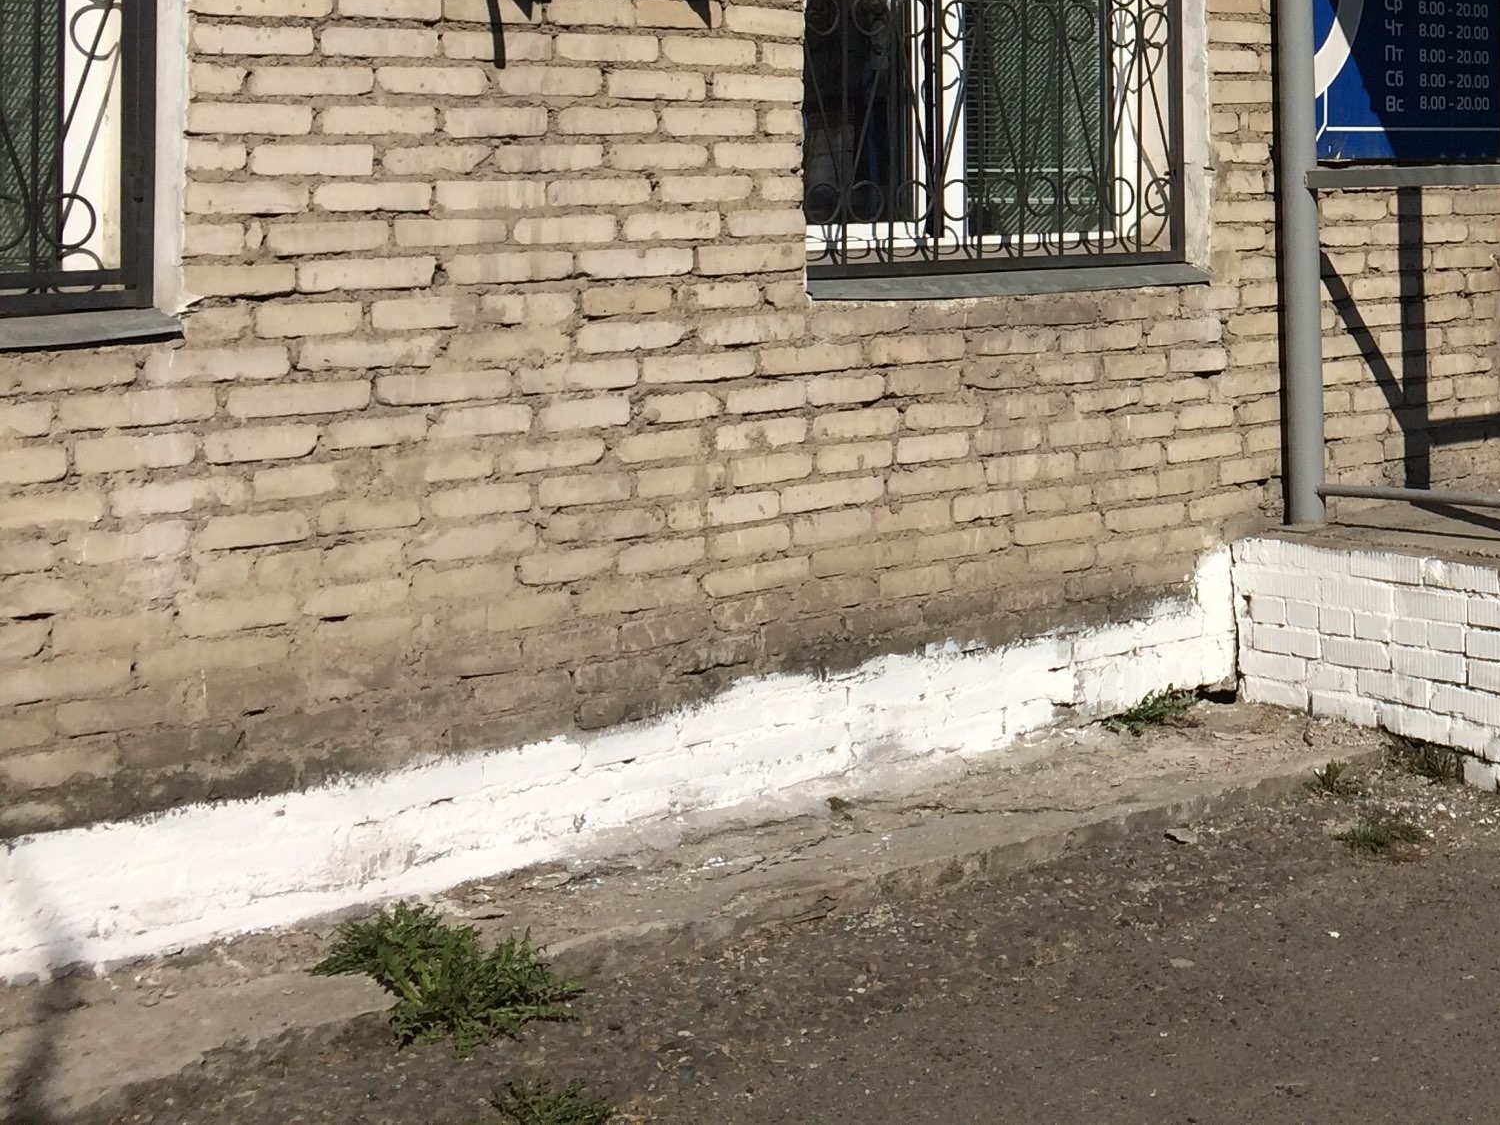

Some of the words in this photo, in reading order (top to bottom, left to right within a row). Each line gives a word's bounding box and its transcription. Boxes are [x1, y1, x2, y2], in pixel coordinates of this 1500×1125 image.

[1418, 0, 1445, 15] 8.00
[1456, 3, 1488, 18] 20.00
[1385, 19, 1403, 37] Чт
[1419, 23, 1445, 38] 8.00
[1456, 25, 1489, 40] 20.00
[1385, 45, 1404, 62] Пт
[1419, 48, 1445, 63] 8.00
[1457, 50, 1489, 64] 20.00
[1385, 70, 1404, 87] Сб
[1419, 73, 1446, 88] 8.00
[1457, 74, 1489, 89] 20.00
[1385, 96, 1404, 112] Вс
[1419, 96, 1446, 110] 8.00
[1457, 96, 1490, 110] 20.00
